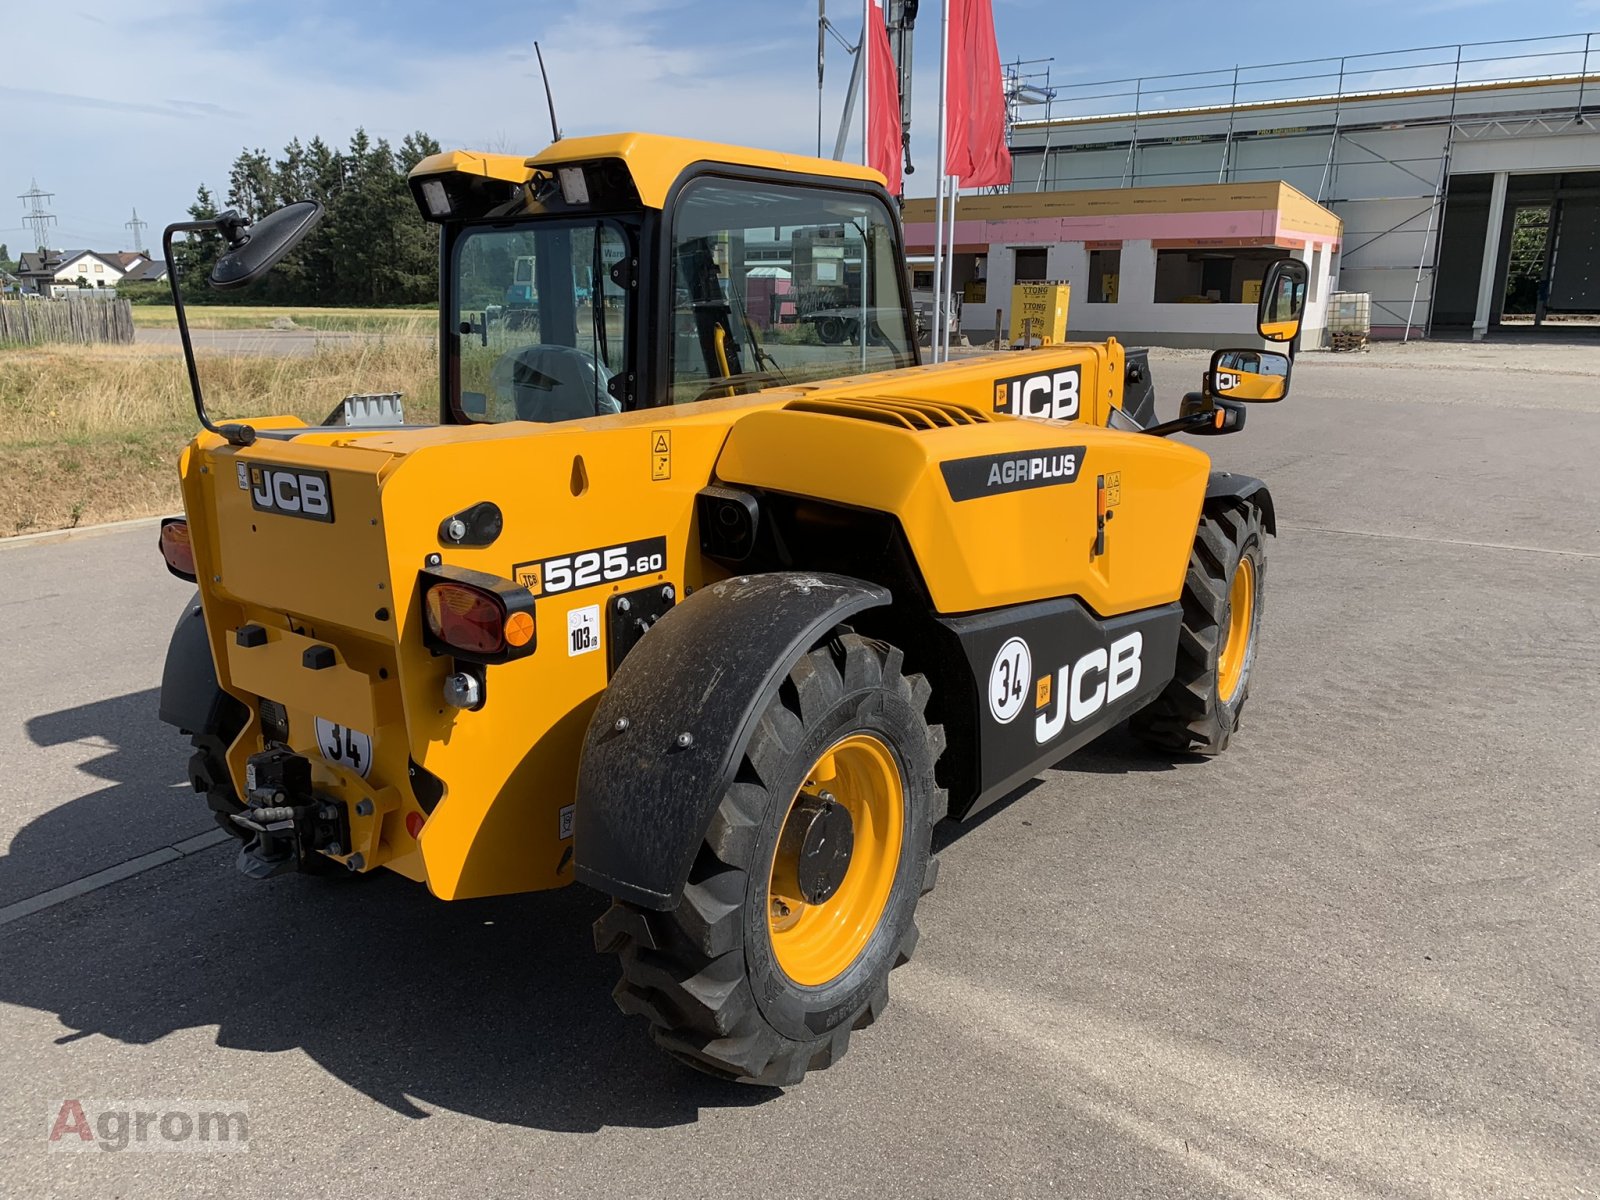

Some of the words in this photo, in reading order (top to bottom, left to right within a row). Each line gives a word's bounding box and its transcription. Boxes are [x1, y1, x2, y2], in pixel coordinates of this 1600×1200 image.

[1023, 286, 1048, 294] YTONG
[1023, 302, 1047, 311] YTONG
[253, 470, 329, 515] JCB
[571, 626, 590, 652] 103
[997, 652, 1022, 708] 34
[1035, 631, 1143, 744] JCB
[327, 723, 362, 769] 34
